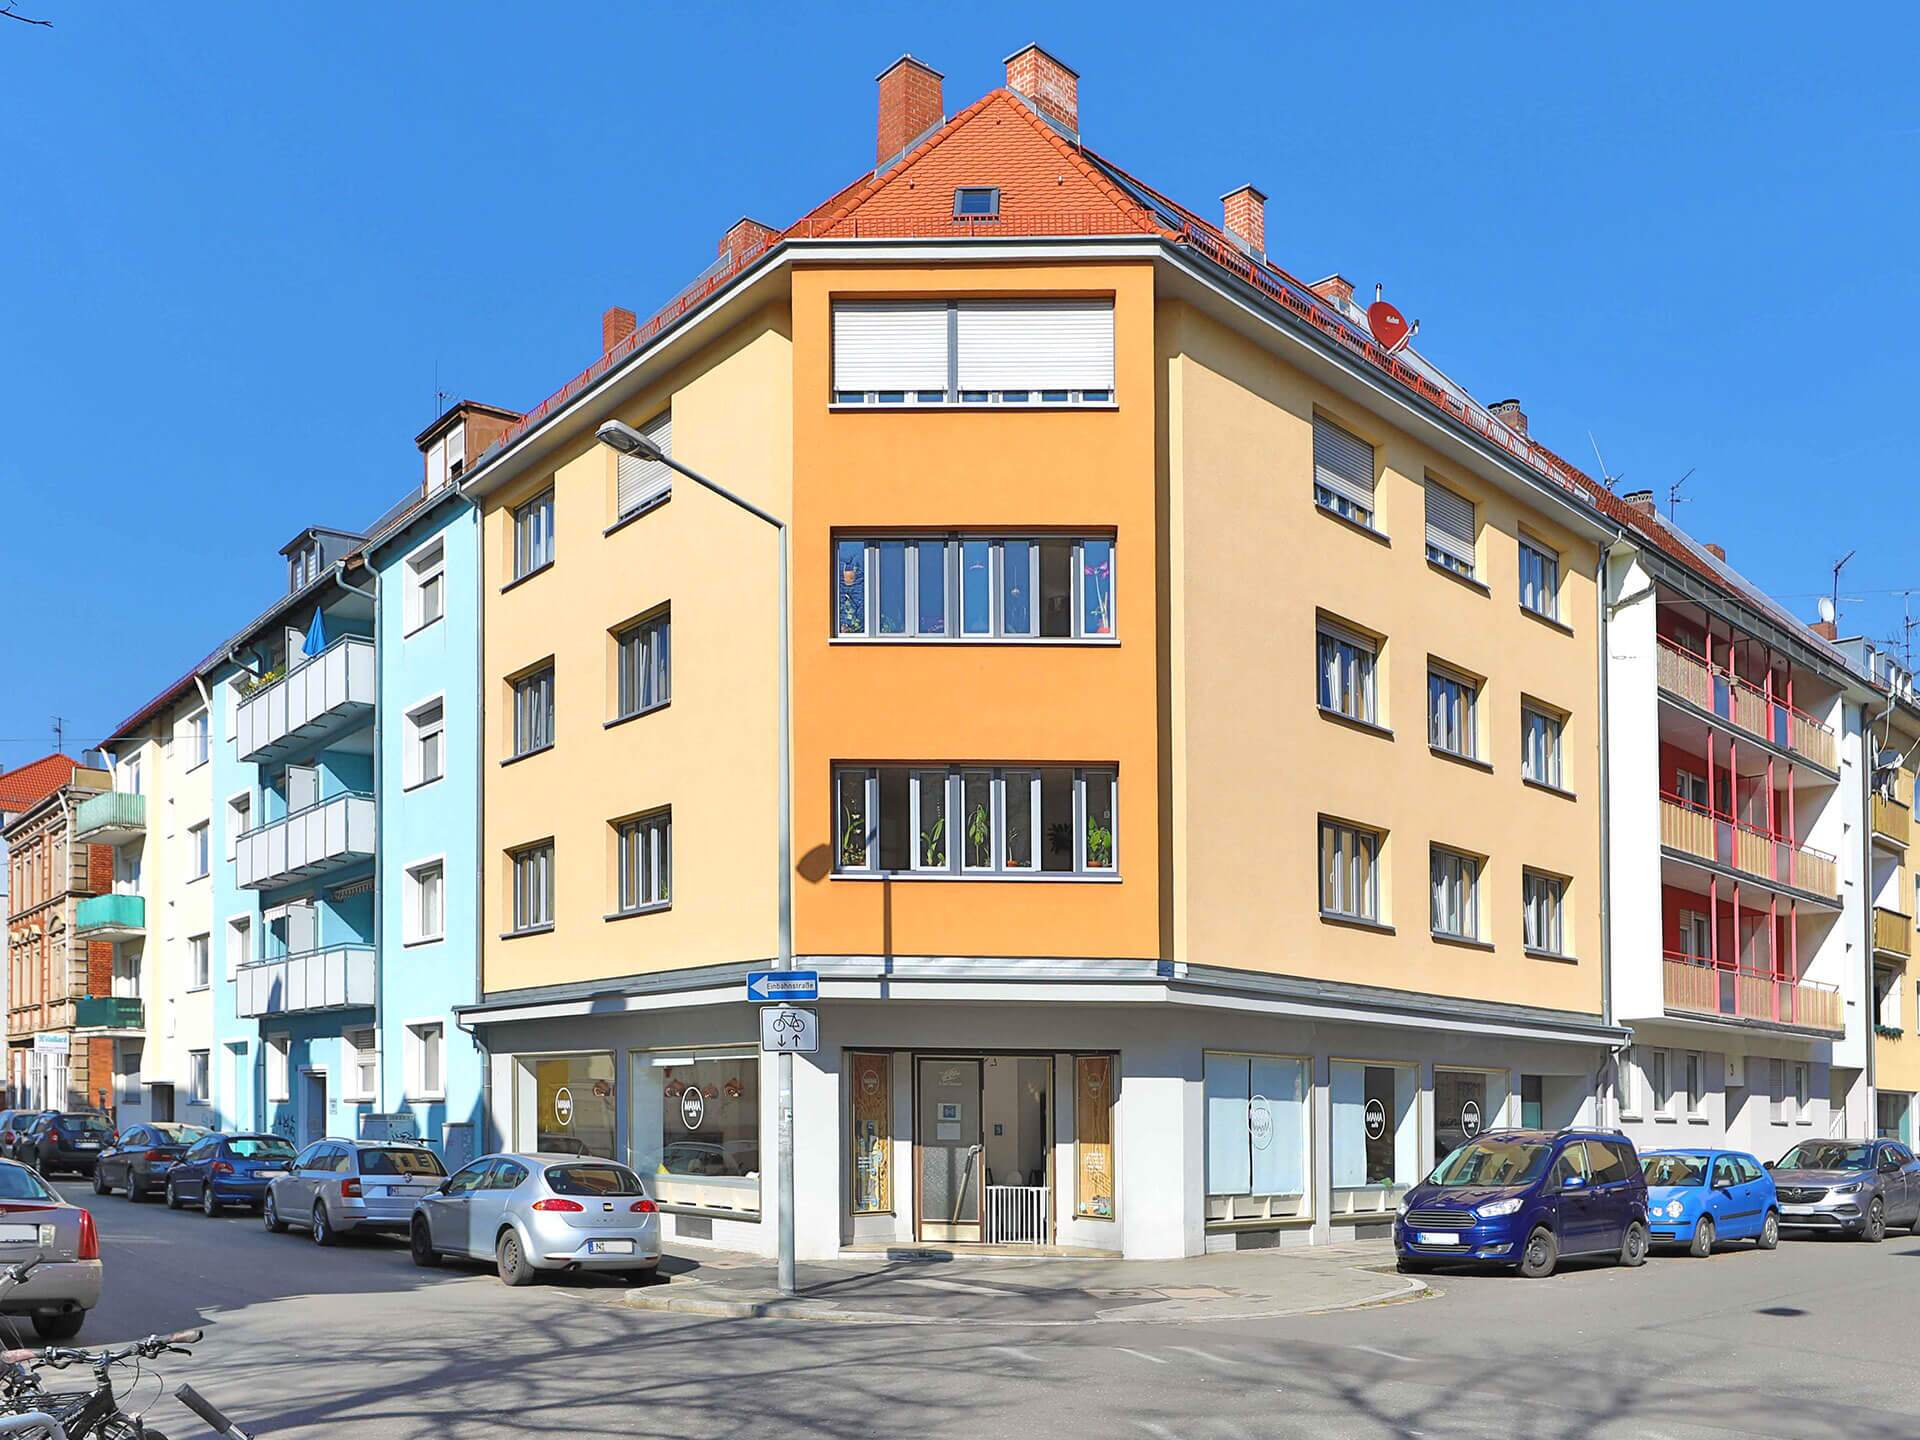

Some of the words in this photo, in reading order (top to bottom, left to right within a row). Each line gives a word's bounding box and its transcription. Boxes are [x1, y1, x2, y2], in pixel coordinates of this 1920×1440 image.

[767, 982, 814, 990] Einbahnstraße
[684, 1100, 702, 1111] MAMA
[1366, 1111, 1383, 1122] MAMA
[1464, 1113, 1479, 1122] MAMA
